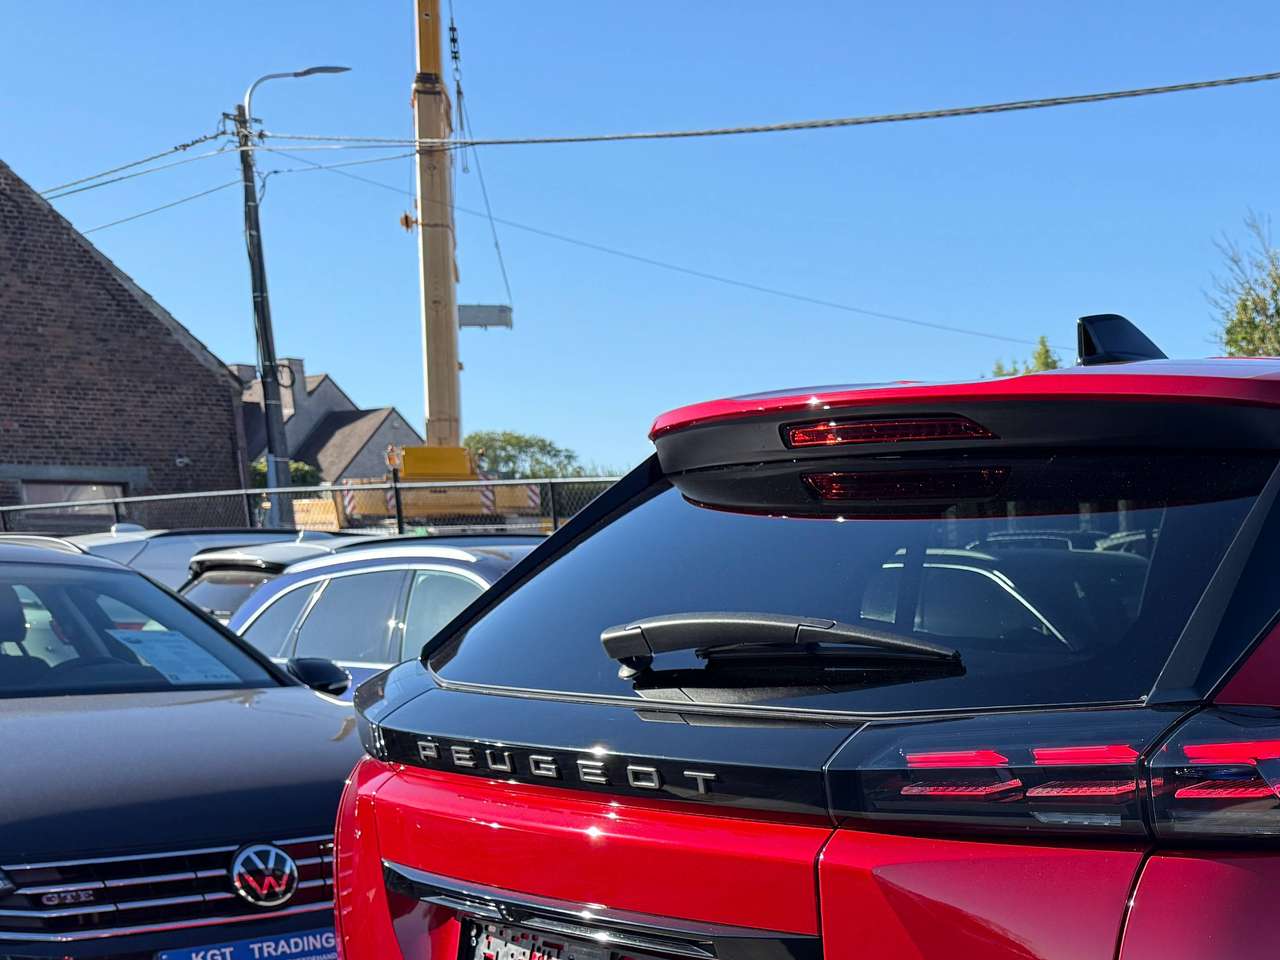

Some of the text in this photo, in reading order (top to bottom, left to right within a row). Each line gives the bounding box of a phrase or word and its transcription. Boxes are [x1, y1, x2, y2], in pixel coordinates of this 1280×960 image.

[417, 741, 717, 794] PEUGEOT
[41, 889, 95, 905] GTE
[249, 932, 336, 960] TRADING
